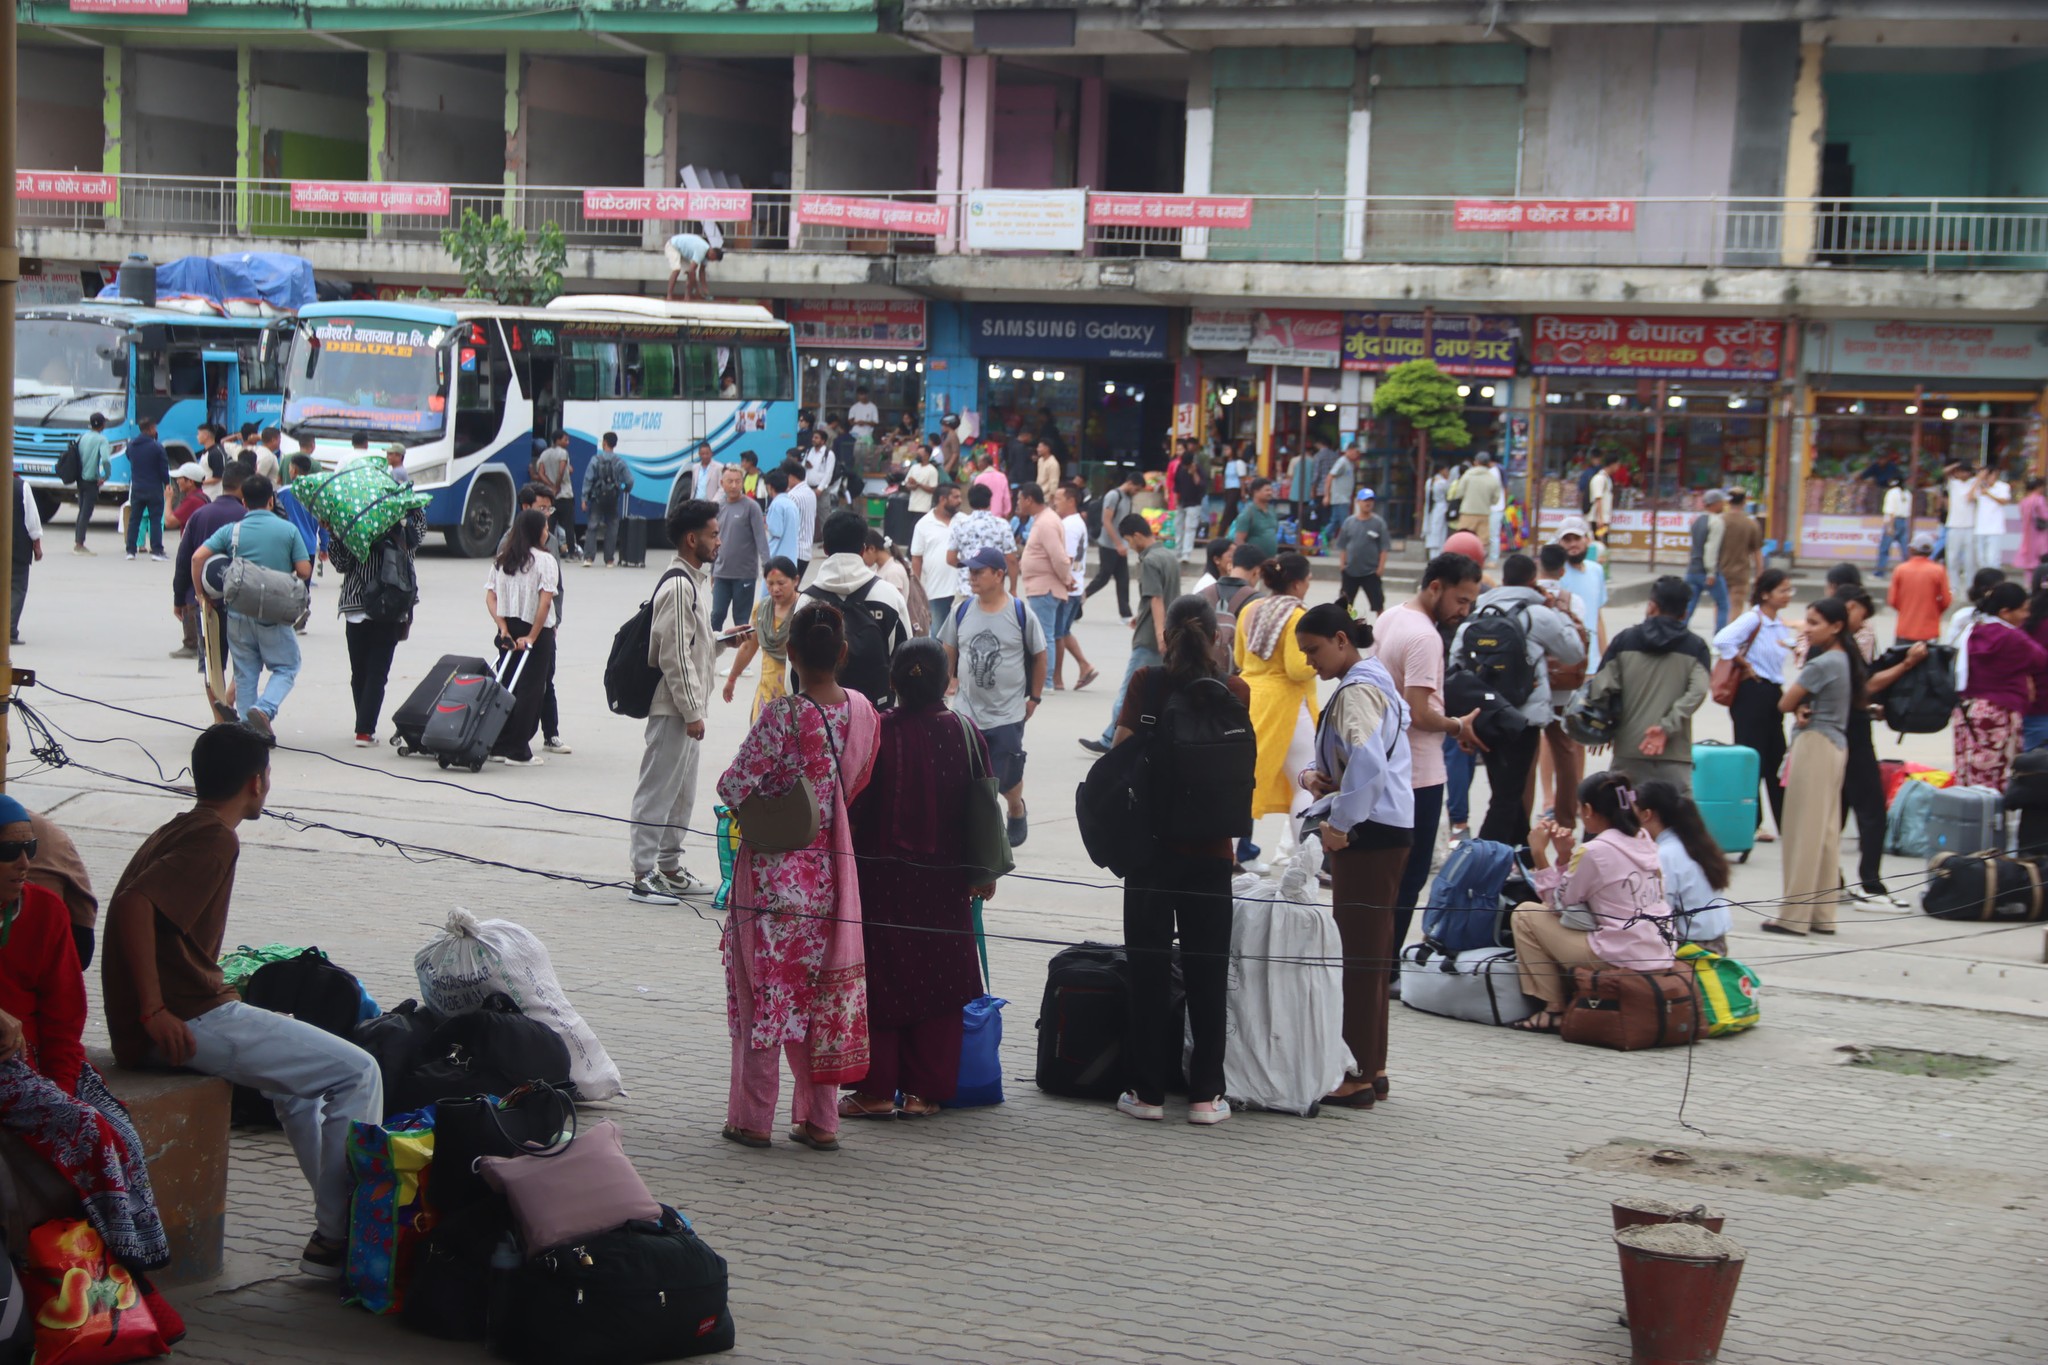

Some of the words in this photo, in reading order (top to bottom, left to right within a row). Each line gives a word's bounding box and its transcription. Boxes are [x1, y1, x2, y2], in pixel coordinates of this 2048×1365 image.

[587, 193, 651, 212] पाकेटमार
[981, 318, 1076, 338] SAMSUNG
[1085, 321, 1155, 345] Galaxy
[1627, 319, 1705, 344] नेपाल
[325, 341, 413, 358] DELUXE
[1434, 338, 1512, 361] भण्डार
[640, 411, 663, 431] VLOGS
[457, 965, 492, 988] SUGAR
